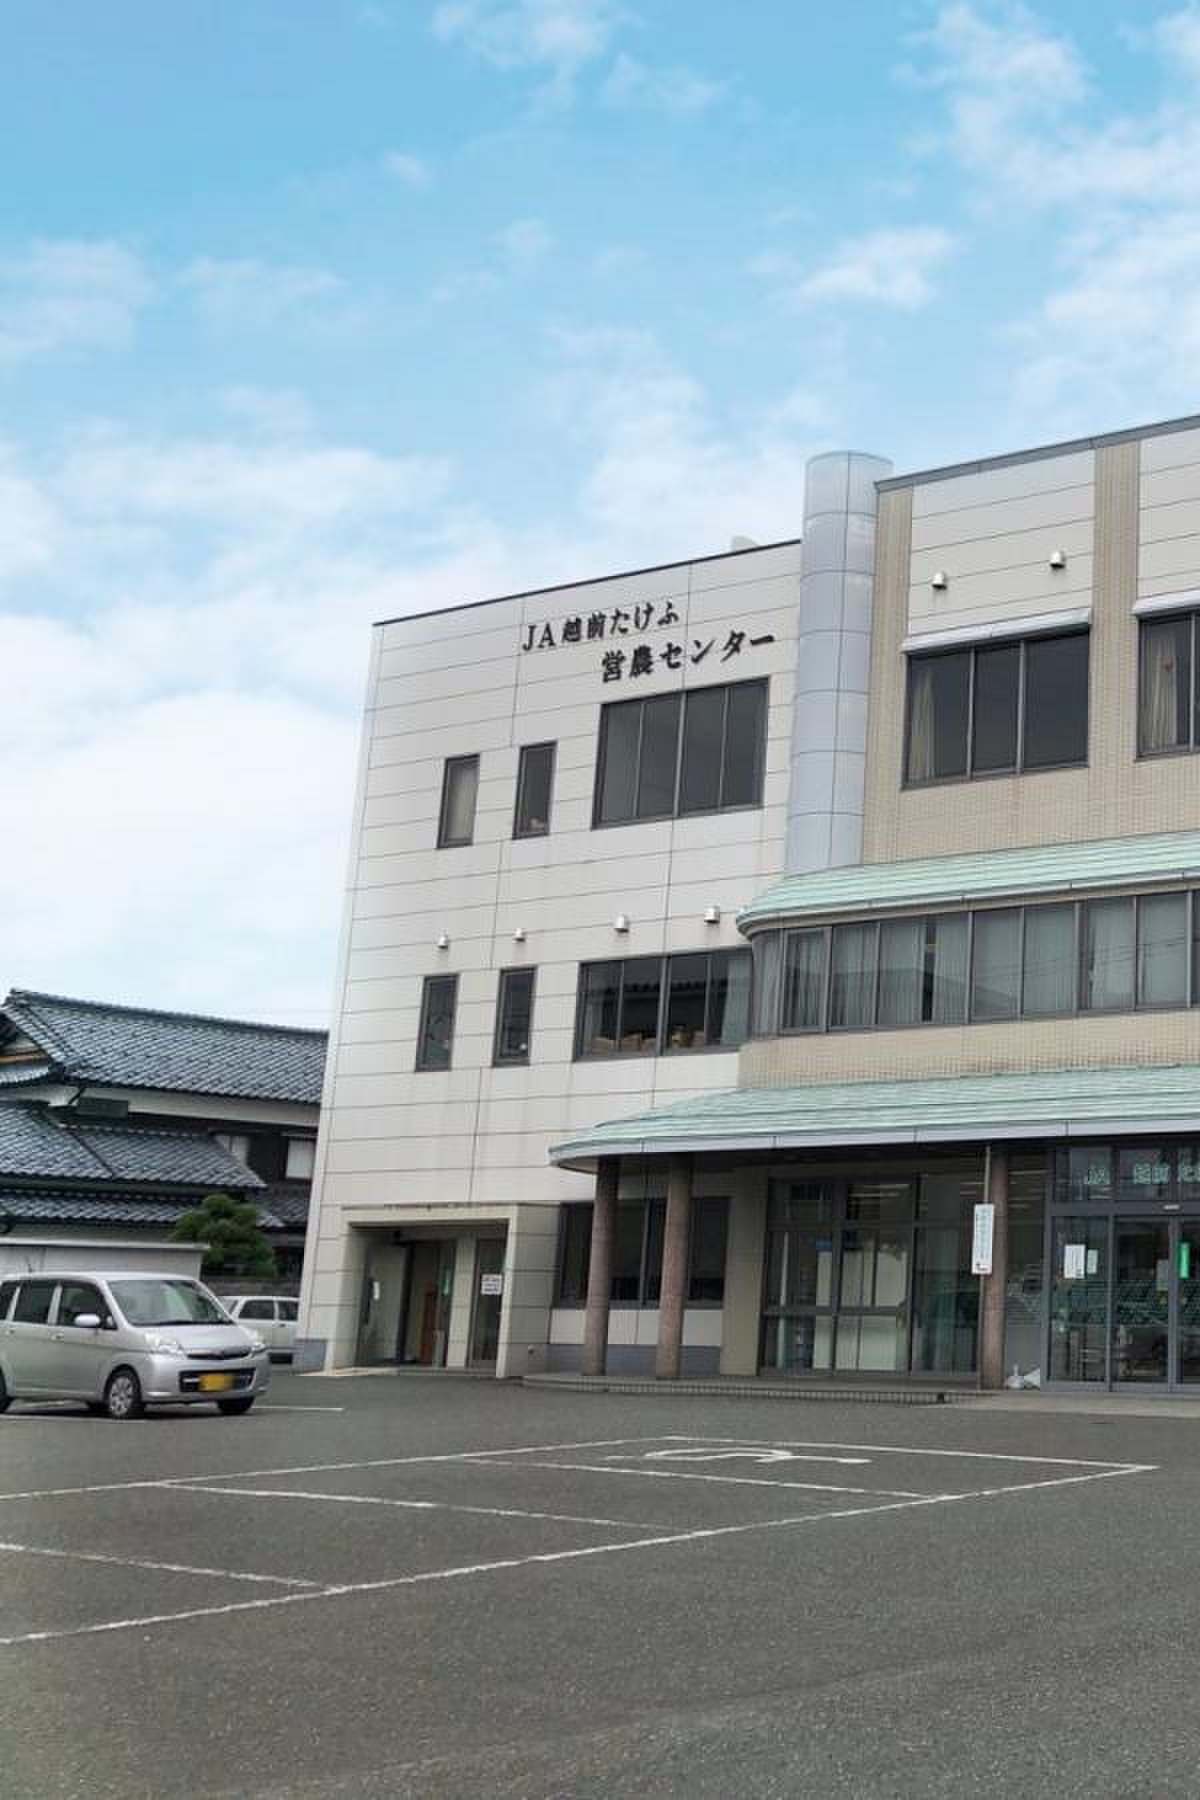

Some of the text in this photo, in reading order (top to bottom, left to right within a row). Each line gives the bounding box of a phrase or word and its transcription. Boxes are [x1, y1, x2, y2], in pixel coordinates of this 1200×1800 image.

[601, 630, 776, 683] 営農センター
